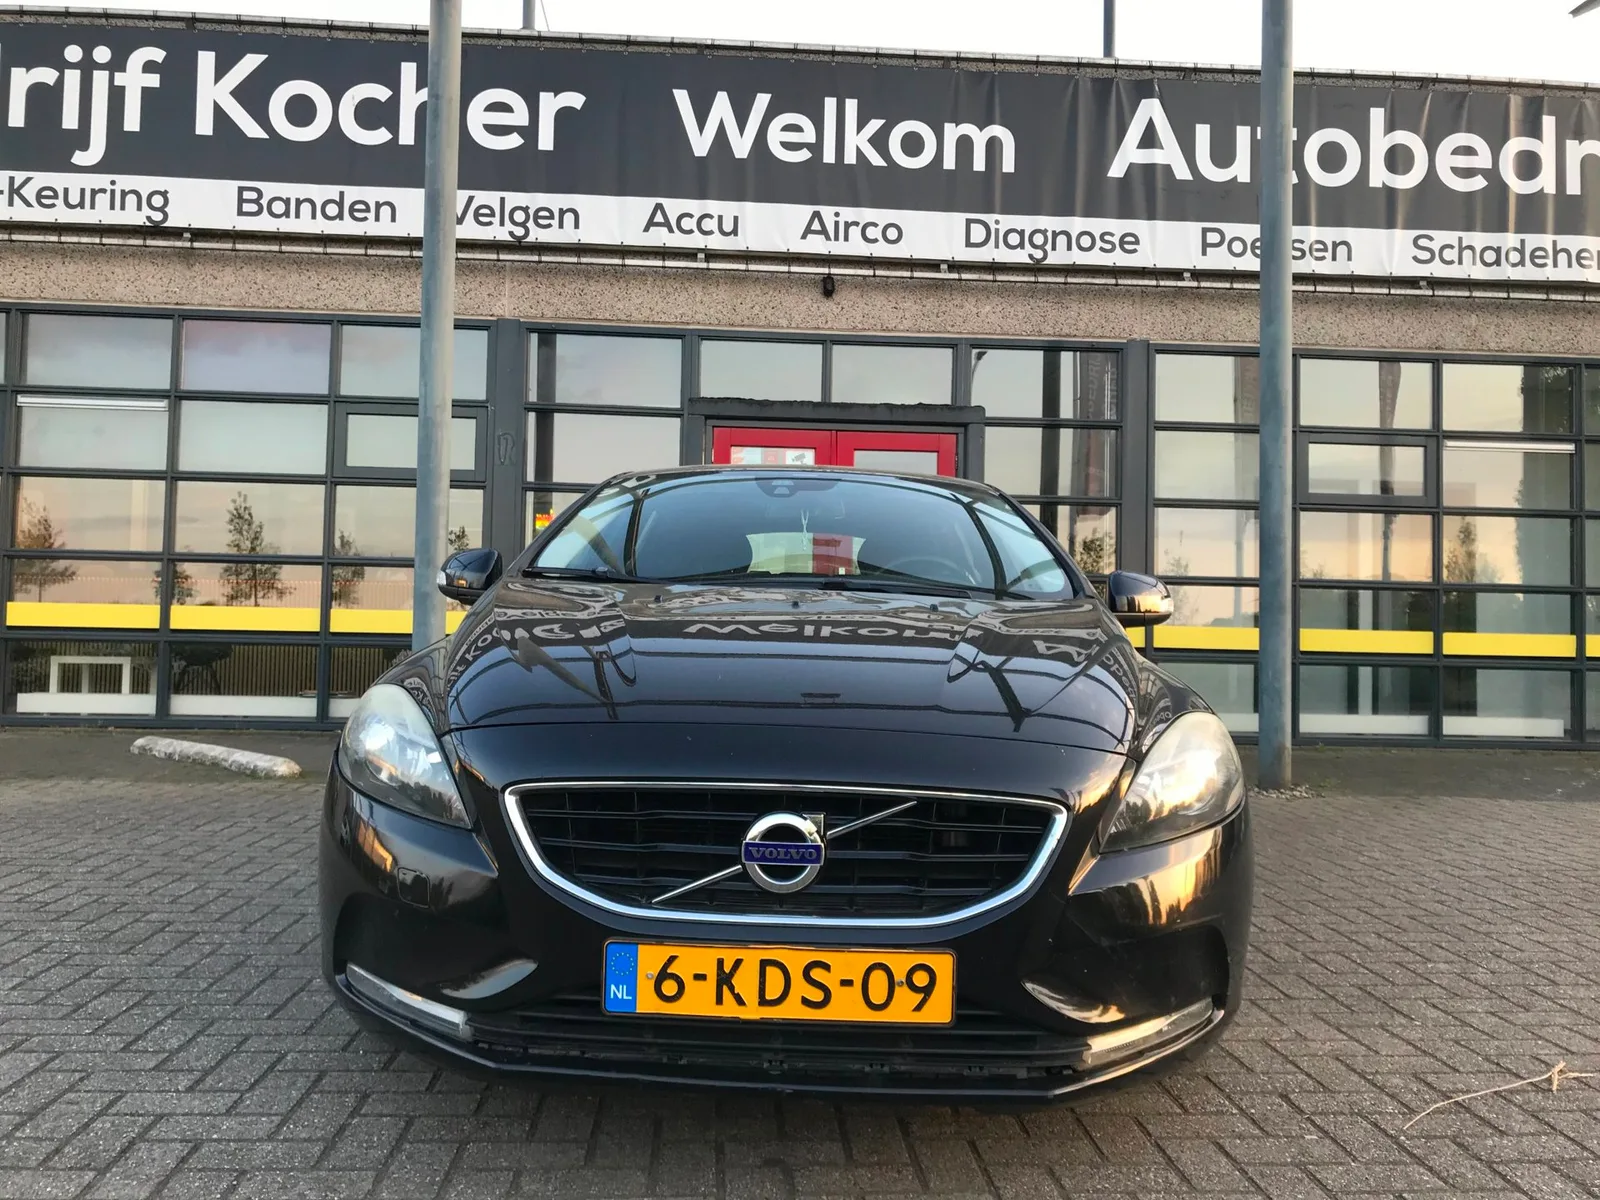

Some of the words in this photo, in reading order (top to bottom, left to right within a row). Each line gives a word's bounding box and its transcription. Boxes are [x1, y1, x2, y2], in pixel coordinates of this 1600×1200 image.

[0, 42, 168, 167] rijf
[195, 50, 588, 153] Kocher
[671, 88, 1016, 174] Welkom
[1106, 97, 1600, 195] Auobedr
[236, 186, 398, 224] Banden
[455, 195, 581, 242] Velgen
[642, 202, 740, 237] Accu
[800, 210, 904, 245] Airco
[964, 218, 1141, 265] Diagnose
[1200, 227, 1353, 263] Poesen
[1411, 234, 1600, 270] Schadehe
[748, 846, 817, 860] VOLVO
[609, 984, 633, 1001] NL
[653, 954, 938, 1012] 6-KDS-09
